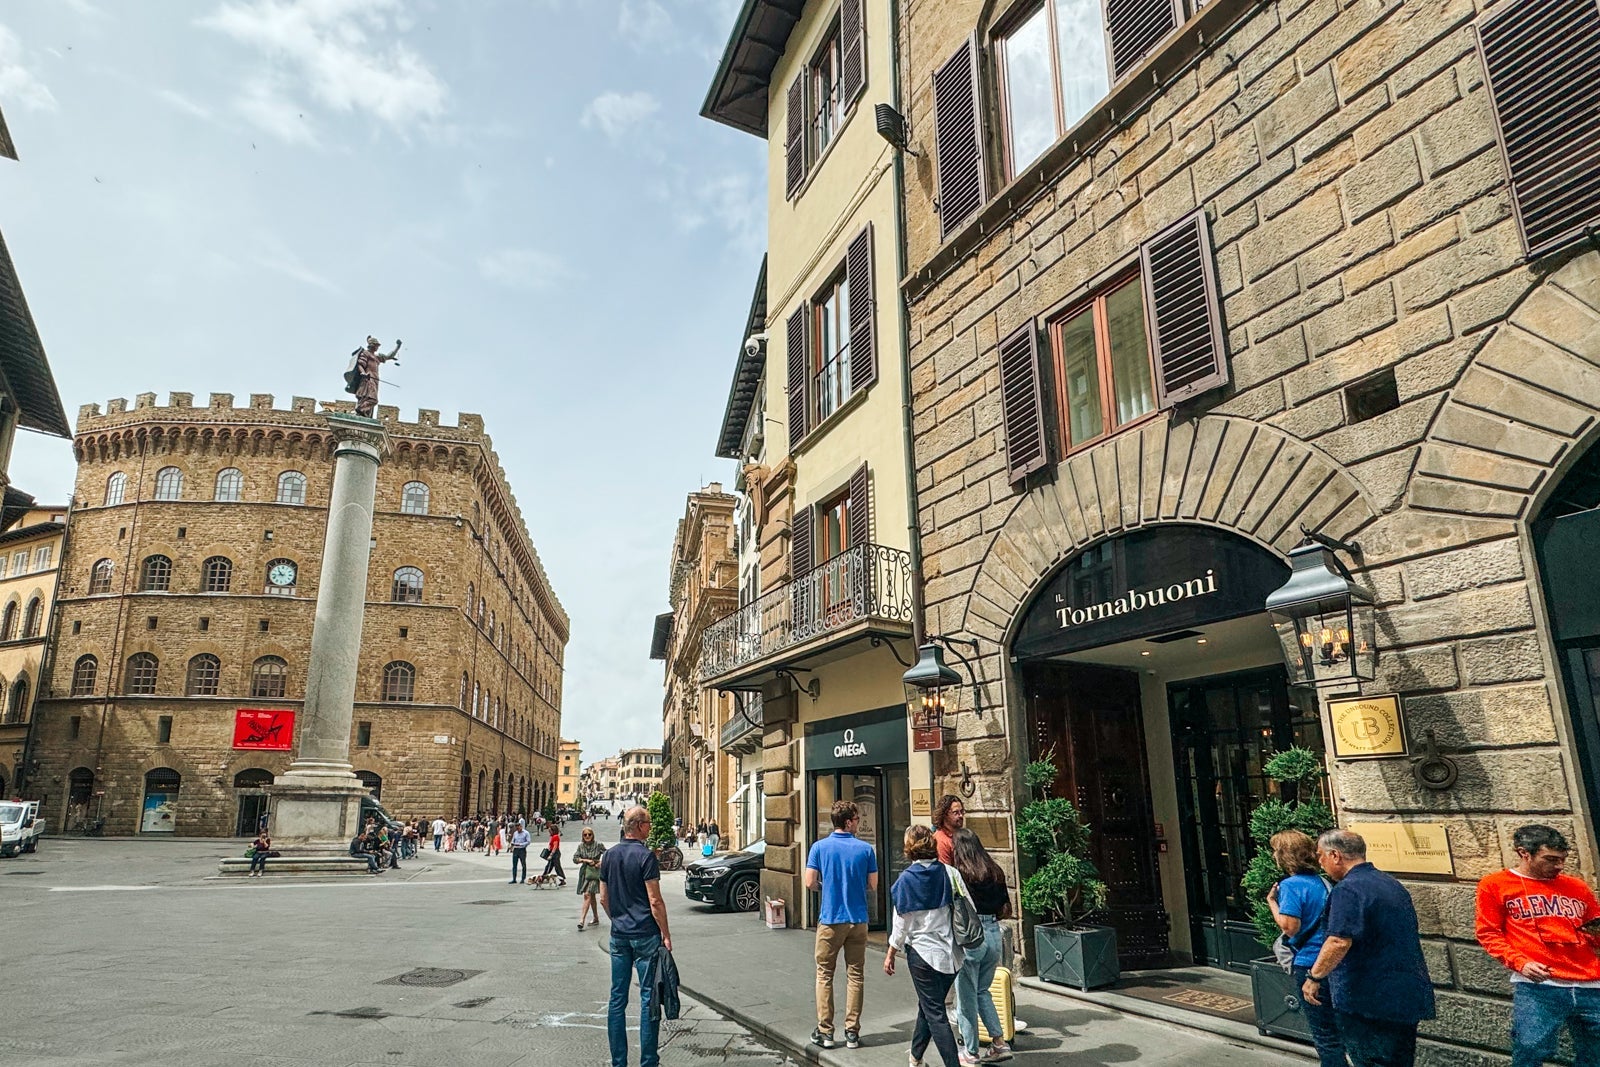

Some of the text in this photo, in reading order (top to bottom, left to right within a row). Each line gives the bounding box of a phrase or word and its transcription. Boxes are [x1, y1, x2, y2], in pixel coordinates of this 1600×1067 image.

[1055, 593, 1065, 603] IL
[1056, 569, 1218, 629] Tornabuoni
[1337, 712, 1347, 724] THE
[1379, 709, 1395, 746] COLLECTION
[834, 742, 867, 758] OMEGA
[1505, 894, 1588, 920] CLEMSO
